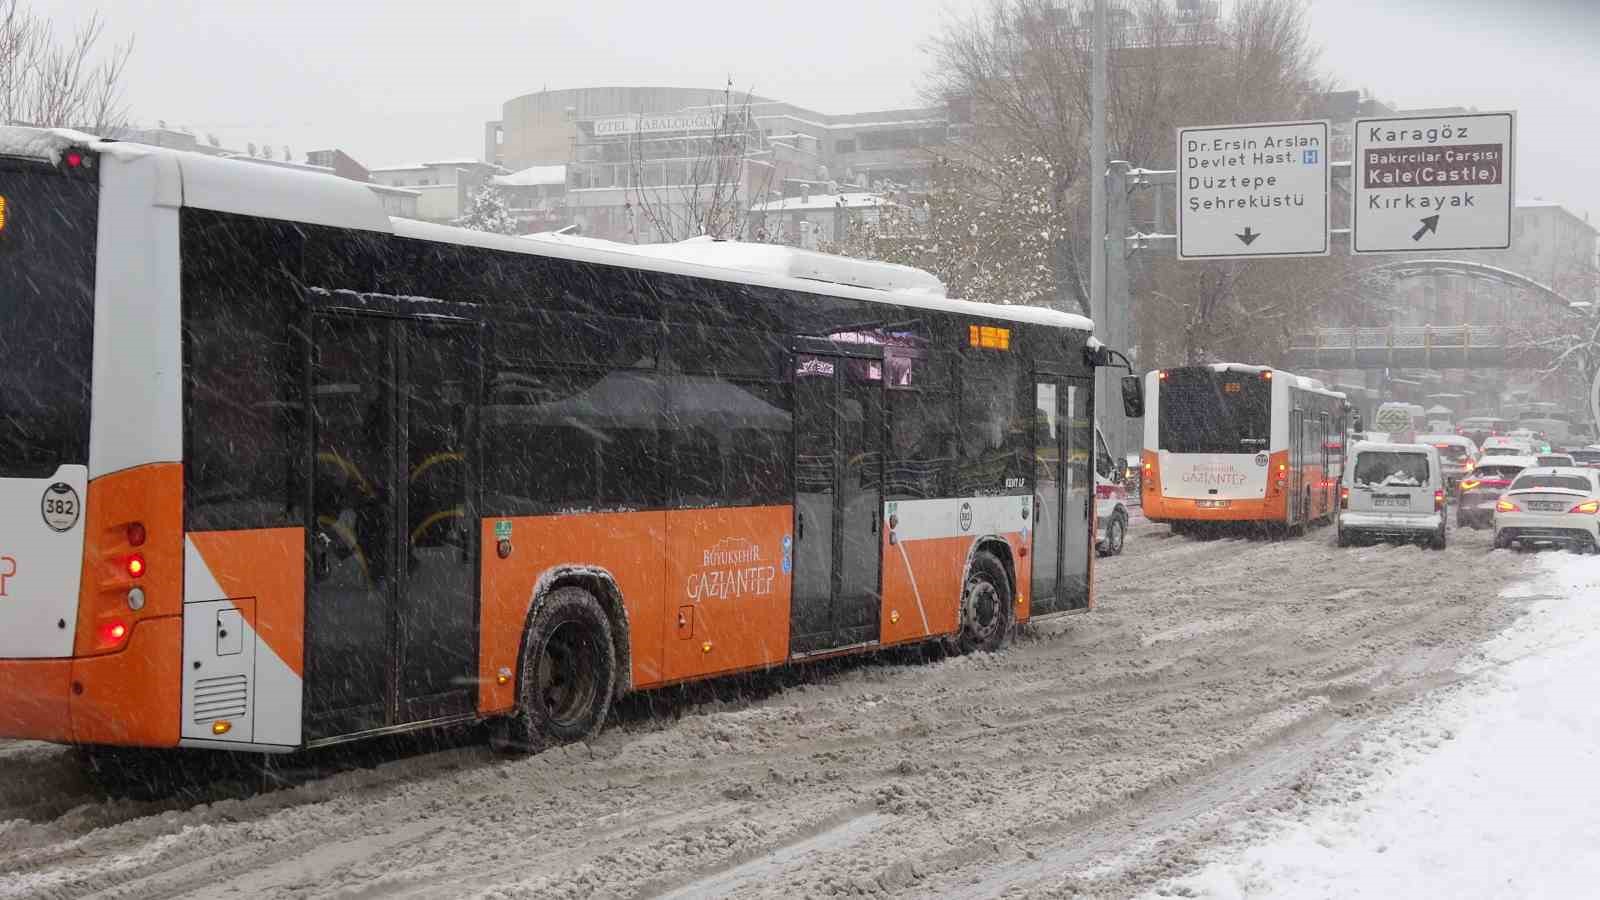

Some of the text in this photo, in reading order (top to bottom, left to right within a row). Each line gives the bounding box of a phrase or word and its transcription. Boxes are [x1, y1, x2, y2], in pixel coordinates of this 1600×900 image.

[1370, 124, 1468, 143] Karagöz
[1264, 136, 1320, 149] Arslan
[1188, 154, 1246, 169] Devlet
[1253, 152, 1297, 165] Hast.
[1189, 175, 1277, 190] Düztepe
[1190, 193, 1304, 212] Şehreküstü
[1369, 192, 1475, 211] Kırkayak
[46, 499, 74, 515] 382
